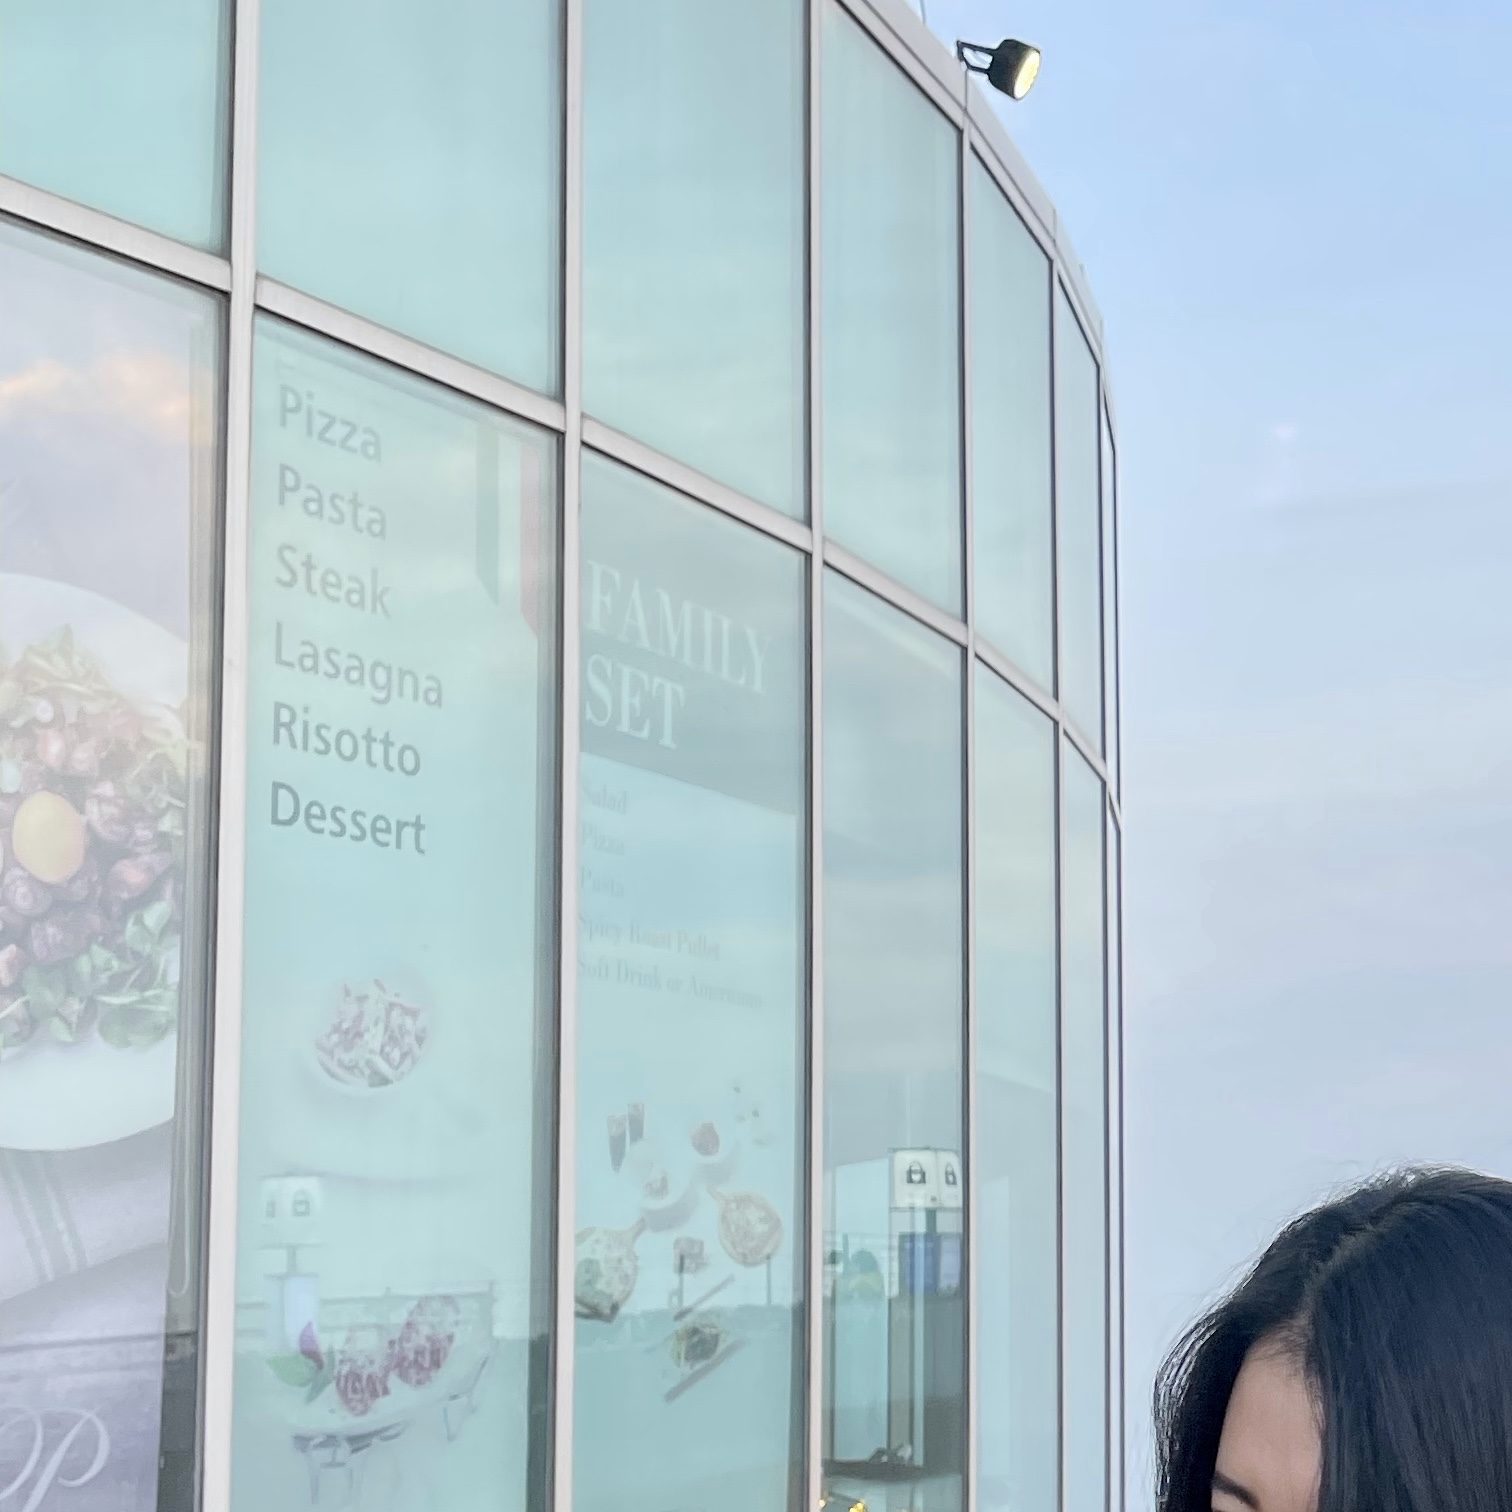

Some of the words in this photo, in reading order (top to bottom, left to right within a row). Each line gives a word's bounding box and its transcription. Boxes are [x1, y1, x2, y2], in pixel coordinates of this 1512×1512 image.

[279, 384, 382, 463] Pizza
[278, 463, 387, 540] Pasta
[275, 543, 392, 619] Steak
[275, 621, 443, 708] Lasagna
[585, 560, 771, 696] FAMILY
[273, 701, 421, 776] Risotto
[585, 653, 686, 749] SET
[271, 781, 426, 855] Dessert
